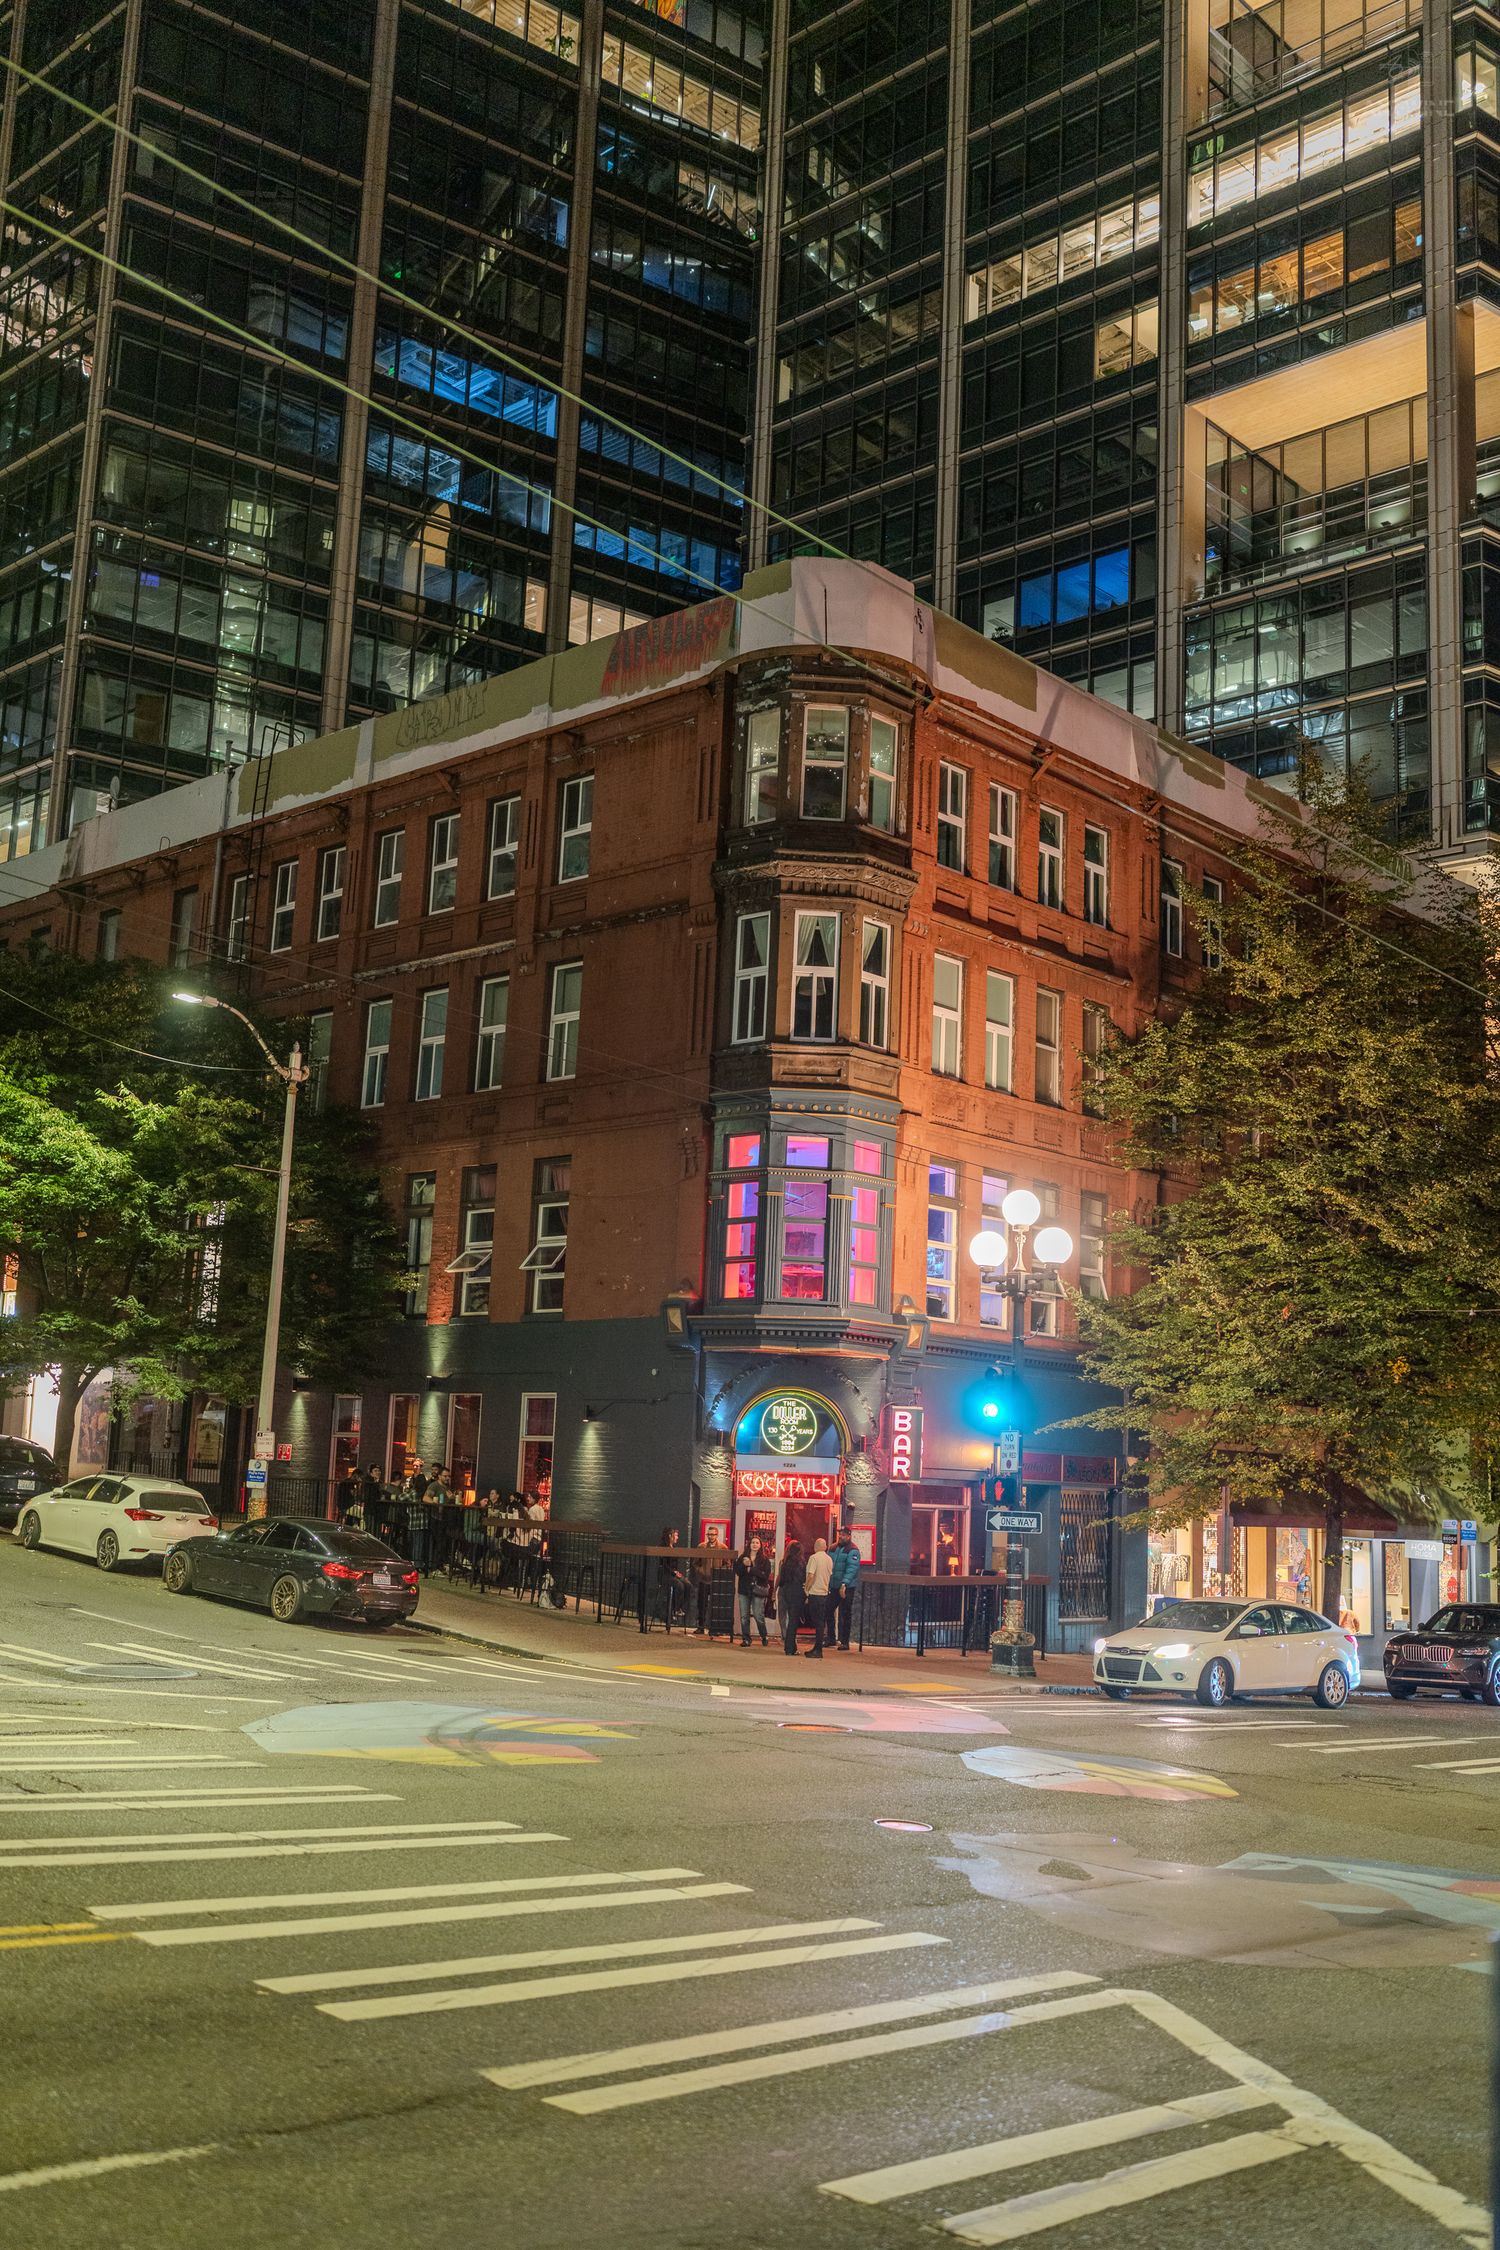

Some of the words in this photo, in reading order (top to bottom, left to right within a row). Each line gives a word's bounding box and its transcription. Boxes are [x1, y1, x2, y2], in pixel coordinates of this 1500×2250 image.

[773, 1406, 807, 1420] DILLER
[893, 1411, 912, 1478] BAR
[741, 1473, 829, 1497] COCKTAILS
[1017, 1518, 1035, 1526] WAY
[1411, 1543, 1437, 1552] HOMA
